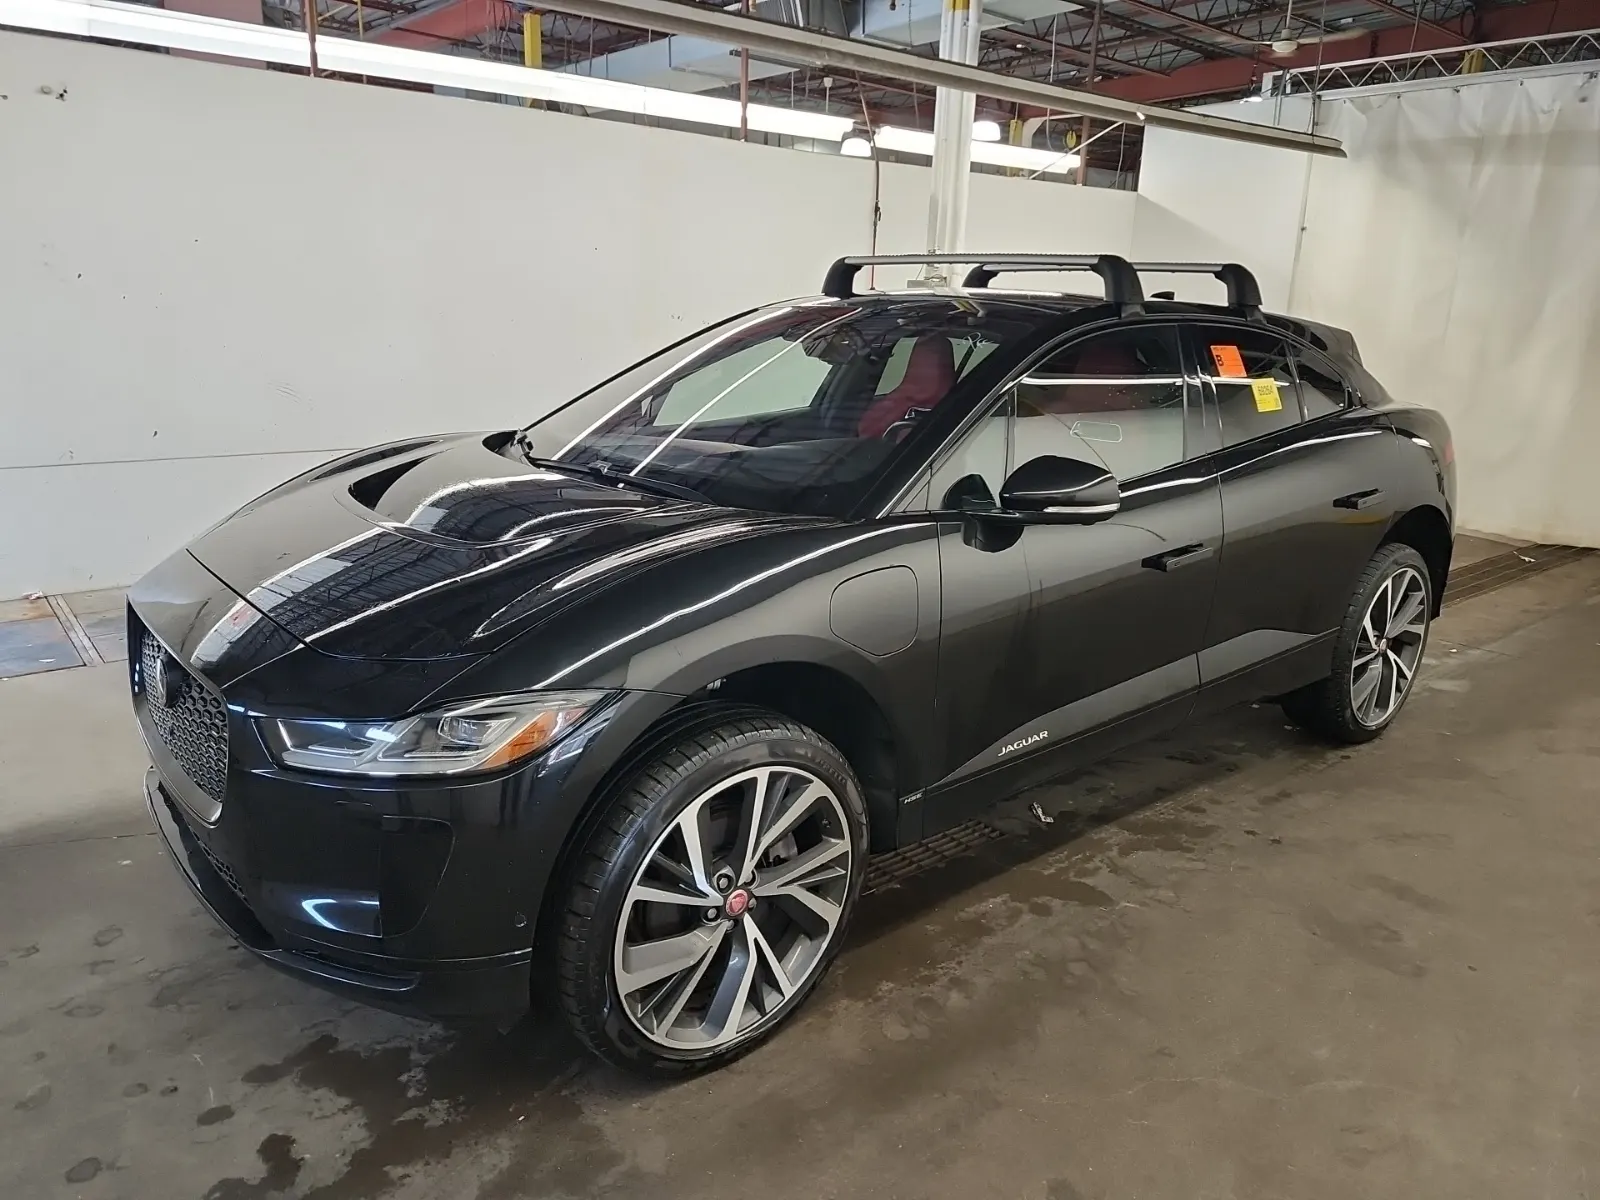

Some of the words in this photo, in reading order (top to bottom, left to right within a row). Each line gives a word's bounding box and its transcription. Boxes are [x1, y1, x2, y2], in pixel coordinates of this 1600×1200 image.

[1215, 354, 1224, 366] B
[997, 730, 1049, 757] JAGUAR
[903, 792, 924, 804] HSE
